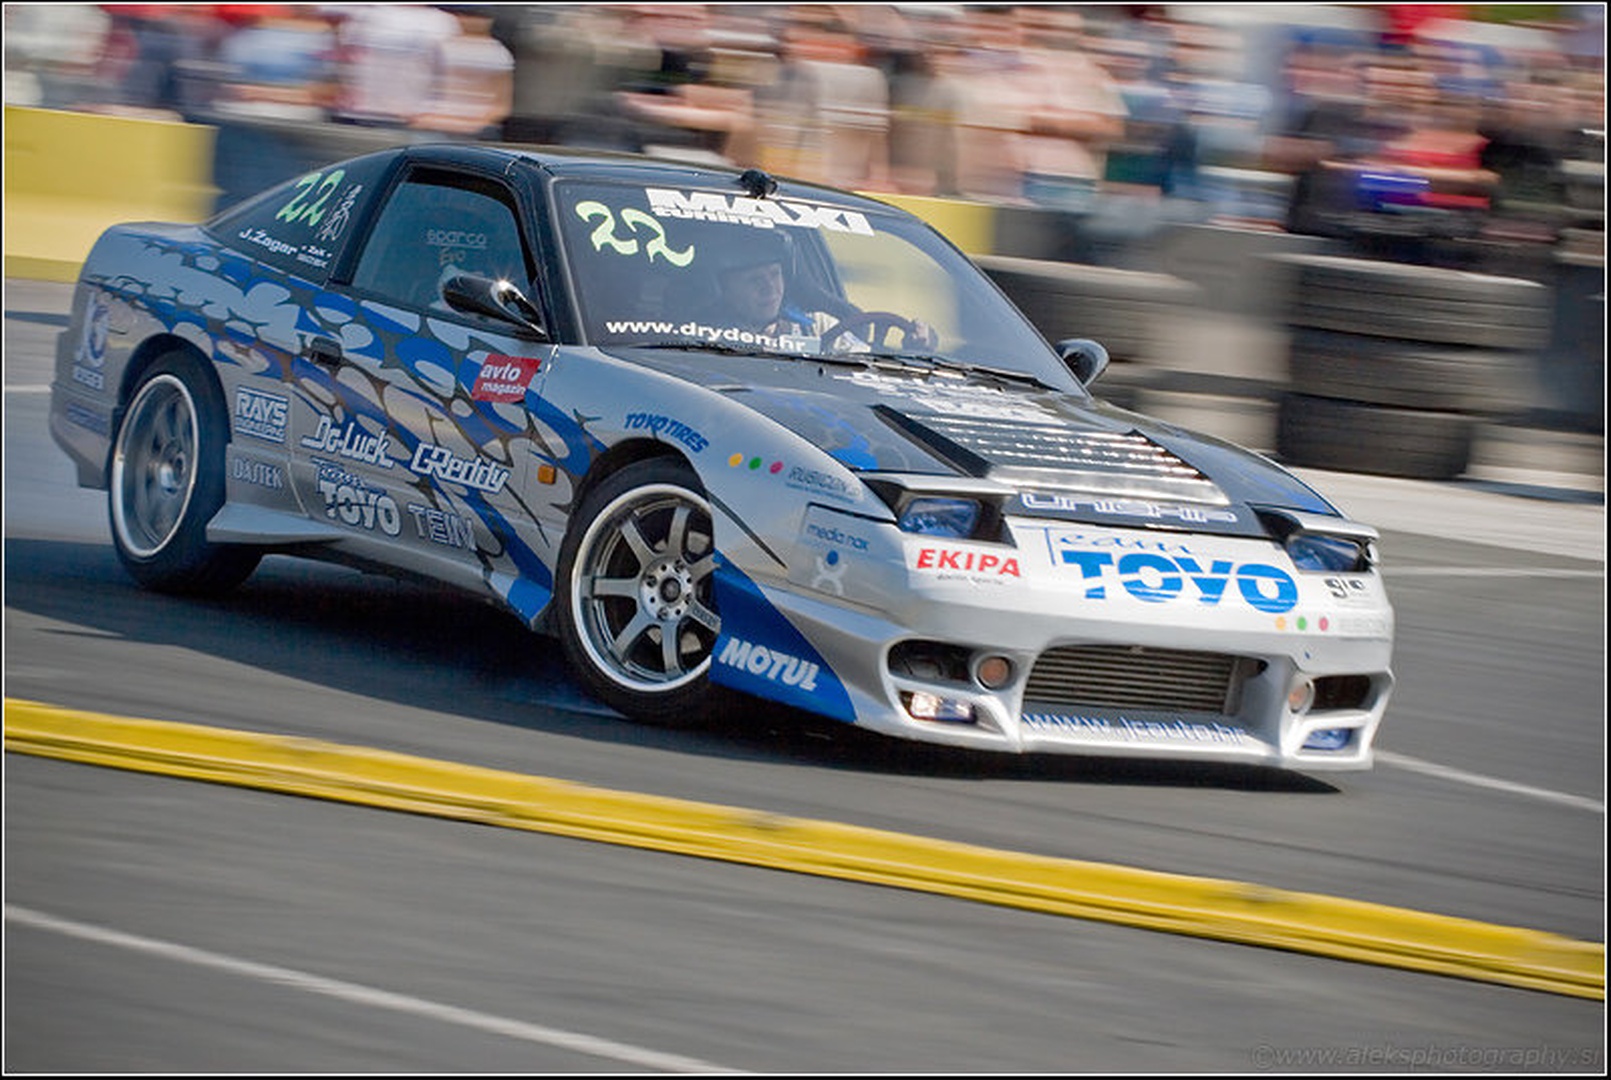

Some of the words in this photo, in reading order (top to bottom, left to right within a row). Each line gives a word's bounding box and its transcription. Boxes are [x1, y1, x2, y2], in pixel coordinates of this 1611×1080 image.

[275, 169, 346, 226] 22
[645, 188, 875, 237] MAXI
[575, 201, 695, 267] 22
[606, 319, 808, 353] www.dryden.hr
[481, 363, 521, 382] avto
[481, 381, 527, 396] magazin
[236, 392, 289, 426] RAYS
[624, 413, 669, 431] TOYO
[663, 419, 710, 453] TIRES
[319, 478, 401, 537] TOYO
[407, 503, 478, 552] TEIN
[917, 548, 1021, 577] EKIPA
[1061, 550, 1299, 614] TOYO
[718, 638, 820, 692] MOTUL
